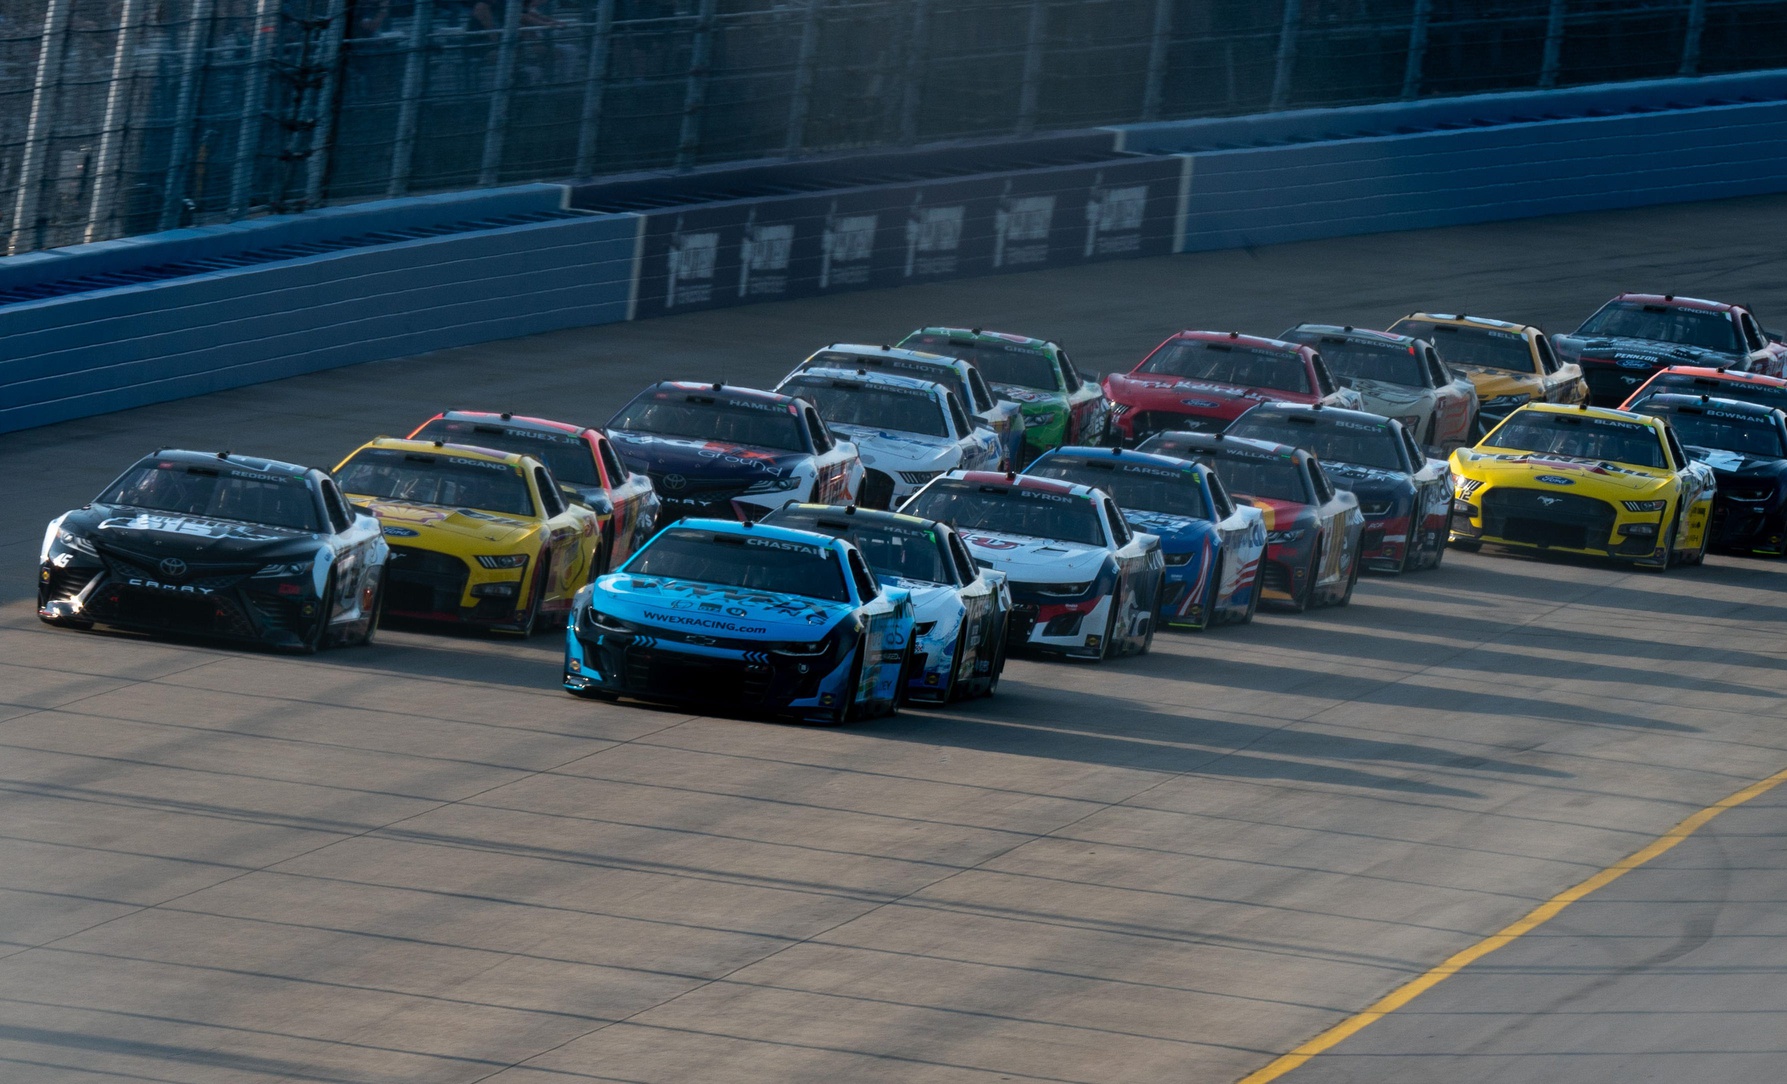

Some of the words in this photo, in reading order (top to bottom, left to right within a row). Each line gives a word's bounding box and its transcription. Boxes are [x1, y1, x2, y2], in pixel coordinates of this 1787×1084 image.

[1677, 306, 1719, 317] CINDRIC
[1488, 330, 1520, 340] BELL
[1614, 353, 1659, 362] PENNZOIL
[893, 361, 945, 374] ELLIOTT
[1730, 382, 1782, 394] HARVICK
[729, 400, 787, 413] HAMLIN
[1706, 410, 1765, 424] BOWMAN
[1335, 420, 1382, 433] BUSCH
[1594, 419, 1641, 431] BLANEY
[507, 430, 558, 442] TRUEX
[1226, 449, 1280, 461] WALLACE
[449, 457, 508, 471] LOGANO
[697, 450, 783, 478] Ground
[231, 470, 288, 483] REDDICK
[1122, 465, 1182, 478] LARSON
[1020, 490, 1073, 504] BYRON
[884, 526, 928, 538] HALEY
[53, 552, 73, 568] 45
[129, 578, 214, 595] CAMRY
[643, 611, 767, 634] WWEXRACING.com
